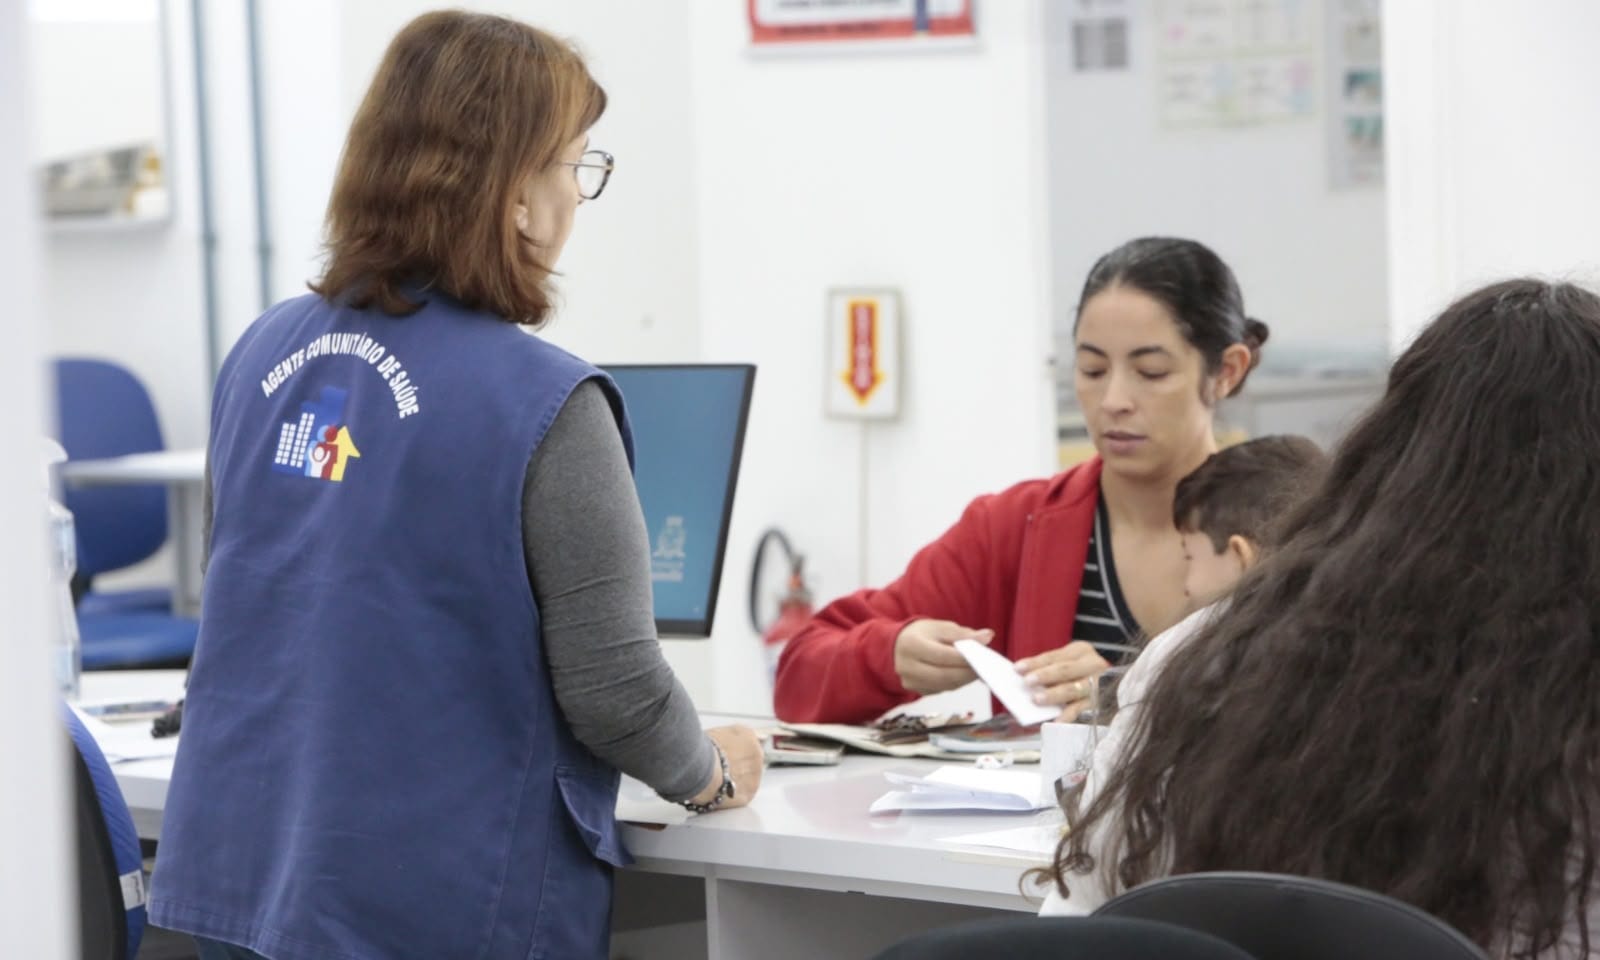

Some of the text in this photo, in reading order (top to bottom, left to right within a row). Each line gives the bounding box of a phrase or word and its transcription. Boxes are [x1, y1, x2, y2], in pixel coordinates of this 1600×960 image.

[261, 332, 420, 419] AGENTE COMUNITÁRIO DE SAÚDE
